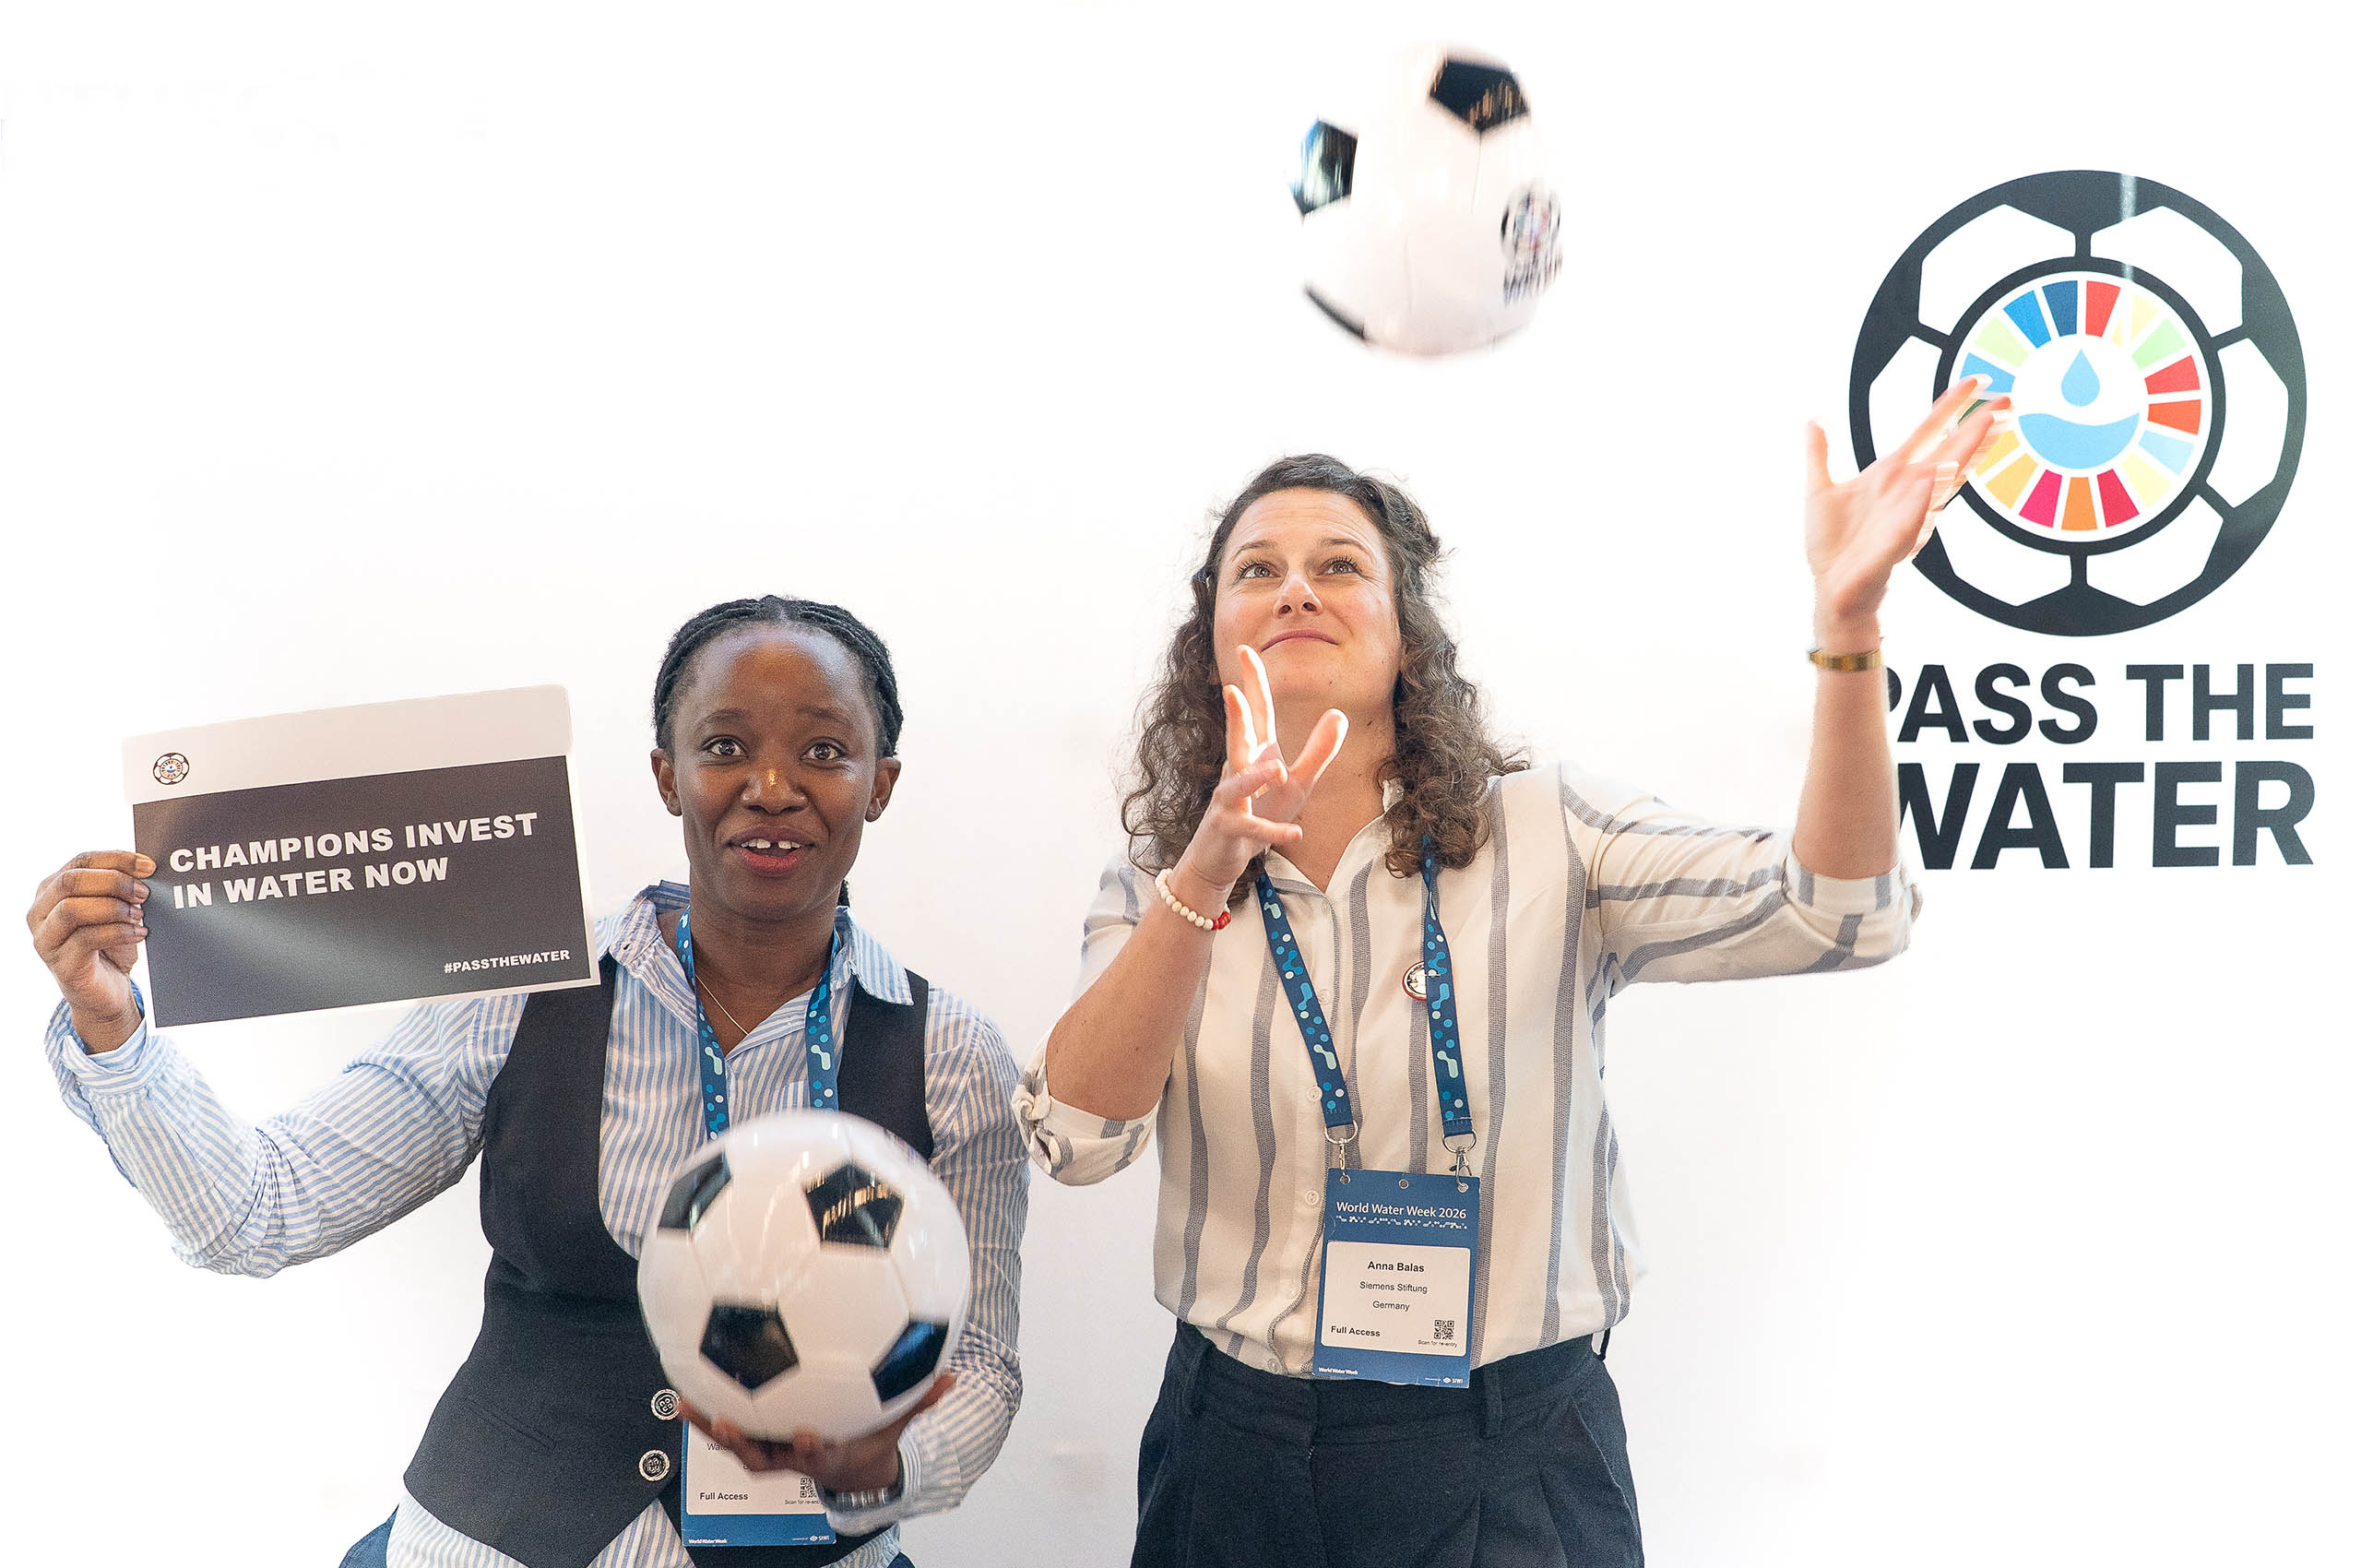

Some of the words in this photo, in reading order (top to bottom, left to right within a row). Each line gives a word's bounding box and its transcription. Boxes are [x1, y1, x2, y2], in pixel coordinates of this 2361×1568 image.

[1887, 662, 2098, 744] ASS
[2126, 663, 2314, 742] THE
[170, 826, 394, 873] CHAMPIONS
[405, 812, 538, 848] INVEST
[172, 882, 212, 909] IN
[222, 866, 356, 903] WATER
[365, 857, 449, 887] NOW
[444, 948, 571, 974] #PASSTHEWATER
[1336, 1202, 1370, 1214] World
[1371, 1205, 1404, 1216] Water
[1406, 1206, 1437, 1218] Week
[1439, 1207, 1466, 1219] 2026
[1367, 1261, 1394, 1272] Anna
[1396, 1262, 1425, 1273] Balas
[1359, 1281, 1394, 1291] Siemens
[1396, 1283, 1428, 1294] Stiftung
[1372, 1301, 1410, 1312] Germany
[1331, 1325, 1347, 1335] Full
[1348, 1327, 1381, 1337] Access
[699, 1491, 716, 1501] Full
[717, 1491, 749, 1501] Access
